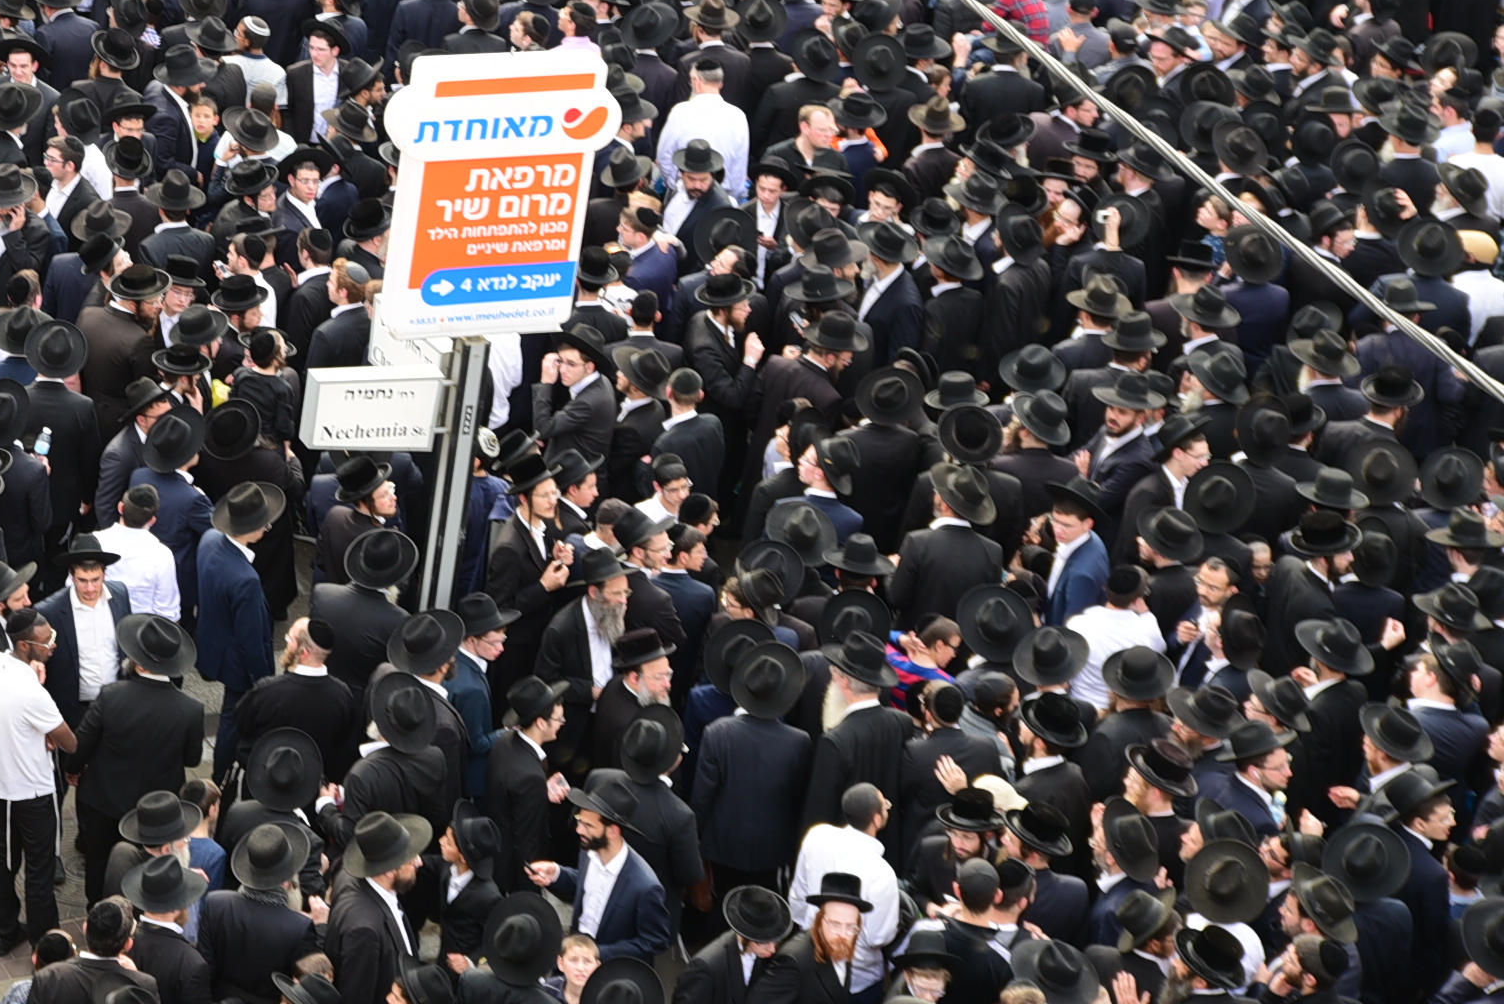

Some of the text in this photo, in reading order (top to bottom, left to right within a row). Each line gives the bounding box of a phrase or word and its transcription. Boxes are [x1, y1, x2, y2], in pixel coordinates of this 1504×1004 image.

[413, 115, 553, 143] מאוחדת
[464, 163, 576, 192] מרפאת
[435, 192, 571, 222] מרום שיר
[426, 221, 568, 241] מכון להתפתחות הילד
[466, 238, 566, 255] ומרפאת שיניים
[460, 272, 561, 292] יעקב לנדא 4
[447, 307, 555, 323] www.meuhedet.co.il
[344, 388, 393, 401] נחמיה
[320, 422, 407, 441] Nechemia
